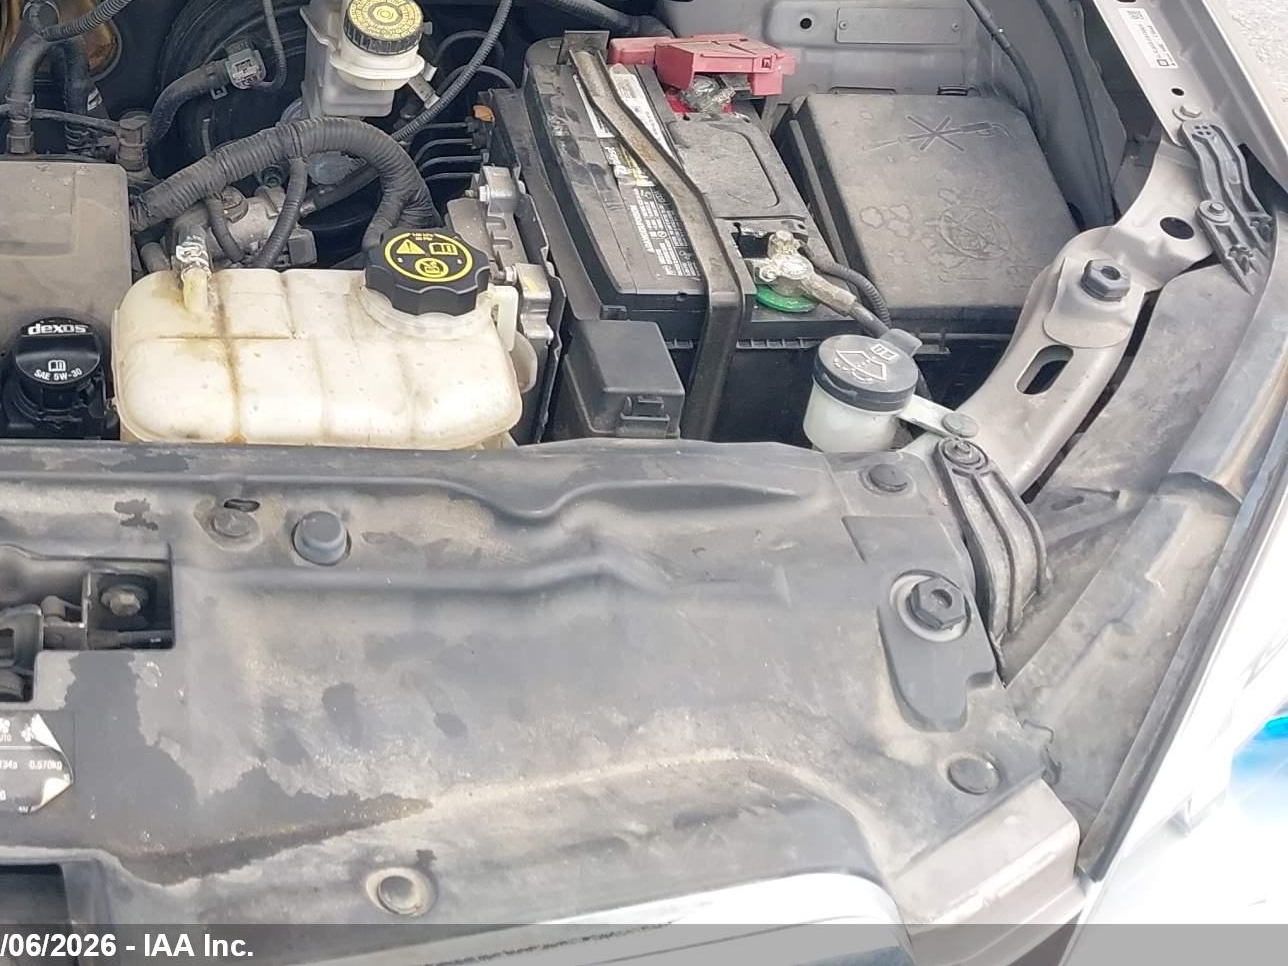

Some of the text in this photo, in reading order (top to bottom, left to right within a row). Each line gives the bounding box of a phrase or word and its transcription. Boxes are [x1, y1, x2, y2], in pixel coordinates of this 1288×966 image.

[28, 323, 89, 335] dexos
[34, 367, 83, 381] SAE 5W-30
